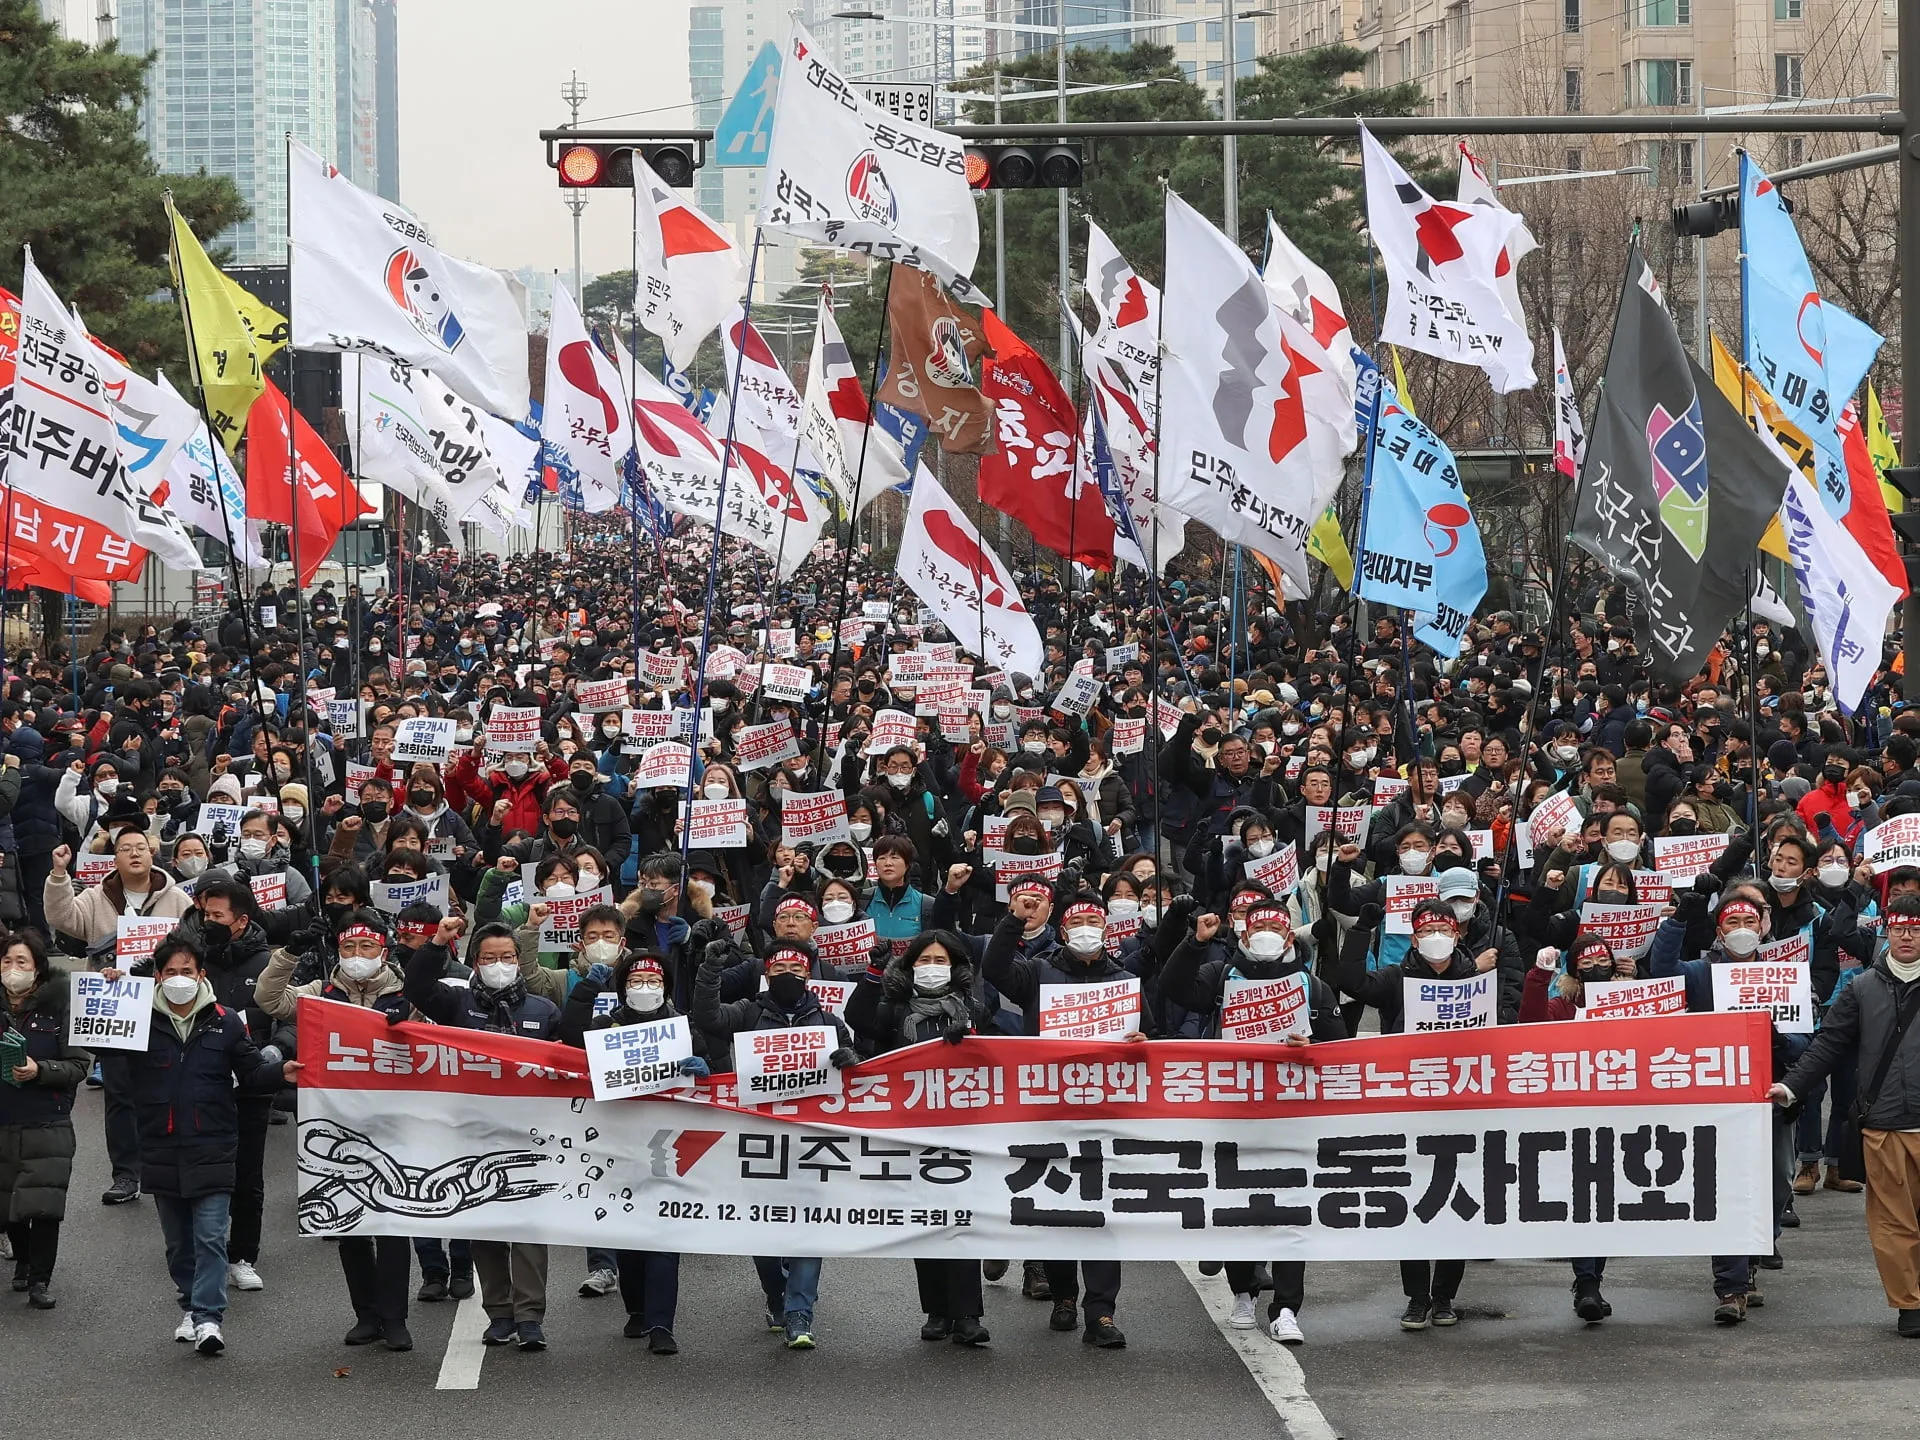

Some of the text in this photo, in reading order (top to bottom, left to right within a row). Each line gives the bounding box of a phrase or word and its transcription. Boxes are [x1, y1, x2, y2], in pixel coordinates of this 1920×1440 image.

[26, 314, 67, 346] 민주노총
[644, 655, 678, 668] 화물안전
[642, 670, 676, 684] 확대하라!
[648, 664, 672, 677] 운임제
[771, 666, 808, 679] 화물안전
[774, 676, 800, 687] 운임제
[580, 686, 602, 697] 노동개악
[767, 683, 804, 698] 확대하라!
[491, 708, 536, 720] 노동개악 저지!
[631, 714, 673, 725] 화물안전
[405, 721, 448, 733] 업무개시
[634, 724, 667, 736] 운임제
[767, 722, 784, 736] 저지!
[412, 732, 434, 744] 명령
[515, 730, 534, 742] 중단!
[757, 738, 776, 750] 2·3조
[398, 742, 446, 758] 철회하라!
[746, 742, 788, 762] 민영화 중단!
[669, 764, 687, 775] 중단!
[720, 800, 739, 812] 저지!
[785, 792, 836, 810] 노동개악 저지!
[704, 816, 725, 826] 2·3조
[783, 810, 822, 824] 노조법 2·3조
[691, 824, 736, 839] 민영화 중단!
[789, 821, 837, 838] 민영화 중단!
[1662, 836, 1721, 855] 노동개악 저지!
[1001, 854, 1055, 872] 노동개악 저지!
[1658, 852, 1708, 868] 노조법 2·3조
[1669, 865, 1696, 879] 민영화
[1640, 875, 1663, 886] 저지!
[387, 879, 440, 900] 업무개시
[1395, 883, 1433, 896] 노동개악
[1646, 889, 1669, 901] 개정!
[1249, 911, 1265, 923] 단결
[1590, 908, 1654, 924] 노동개악 저지!
[126, 923, 169, 938] 노동개악
[847, 923, 868, 937] 저지!
[1613, 923, 1636, 935] 2·3조
[121, 939, 150, 954] 노조법
[829, 943, 854, 954] 2·3조
[1625, 935, 1646, 950] 중단!
[1781, 938, 1802, 953] 저지!
[845, 953, 868, 965] 중단!
[1730, 967, 1798, 986] 화물안전
[78, 976, 141, 1000] 업무개시
[1051, 982, 1130, 1008] 노동개악 저지!
[1228, 979, 1292, 1005] 노동개악 저지!
[1420, 978, 1487, 1002] 업무개시
[1596, 980, 1676, 1007] 노동개악 저지!
[1739, 986, 1790, 1004] 운임제
[85, 997, 119, 1017] 명령
[1044, 996, 1137, 1027] 노조법 2·3조 개정!
[1224, 990, 1303, 1024] 노조법 2·3조 개정!
[1437, 1001, 1472, 1019] 명령
[1626, 996, 1682, 1017] 2·3조 개정!
[74, 1016, 137, 1039] 철회하라!
[1098, 1017, 1125, 1034] 중단!
[1234, 1015, 1297, 1040] 민영화 중단!
[604, 1023, 676, 1051] 업무개시
[753, 1033, 826, 1054] 화물안전
[624, 1045, 659, 1066] 명령
[762, 1051, 817, 1073] 운임제
[604, 1060, 681, 1088] 철회하라!
[750, 1068, 827, 1092] 확대하라!
[903, 1045, 1751, 1110] 개정! 민영화 중단! 화물노동자 총파업 승리!
[737, 1132, 973, 1185] 민주노총
[1004, 1124, 1717, 1230] 전국노동자대회
[659, 1201, 973, 1227] 2022. 12. 3(토) 14시 여의도 국회 앞
